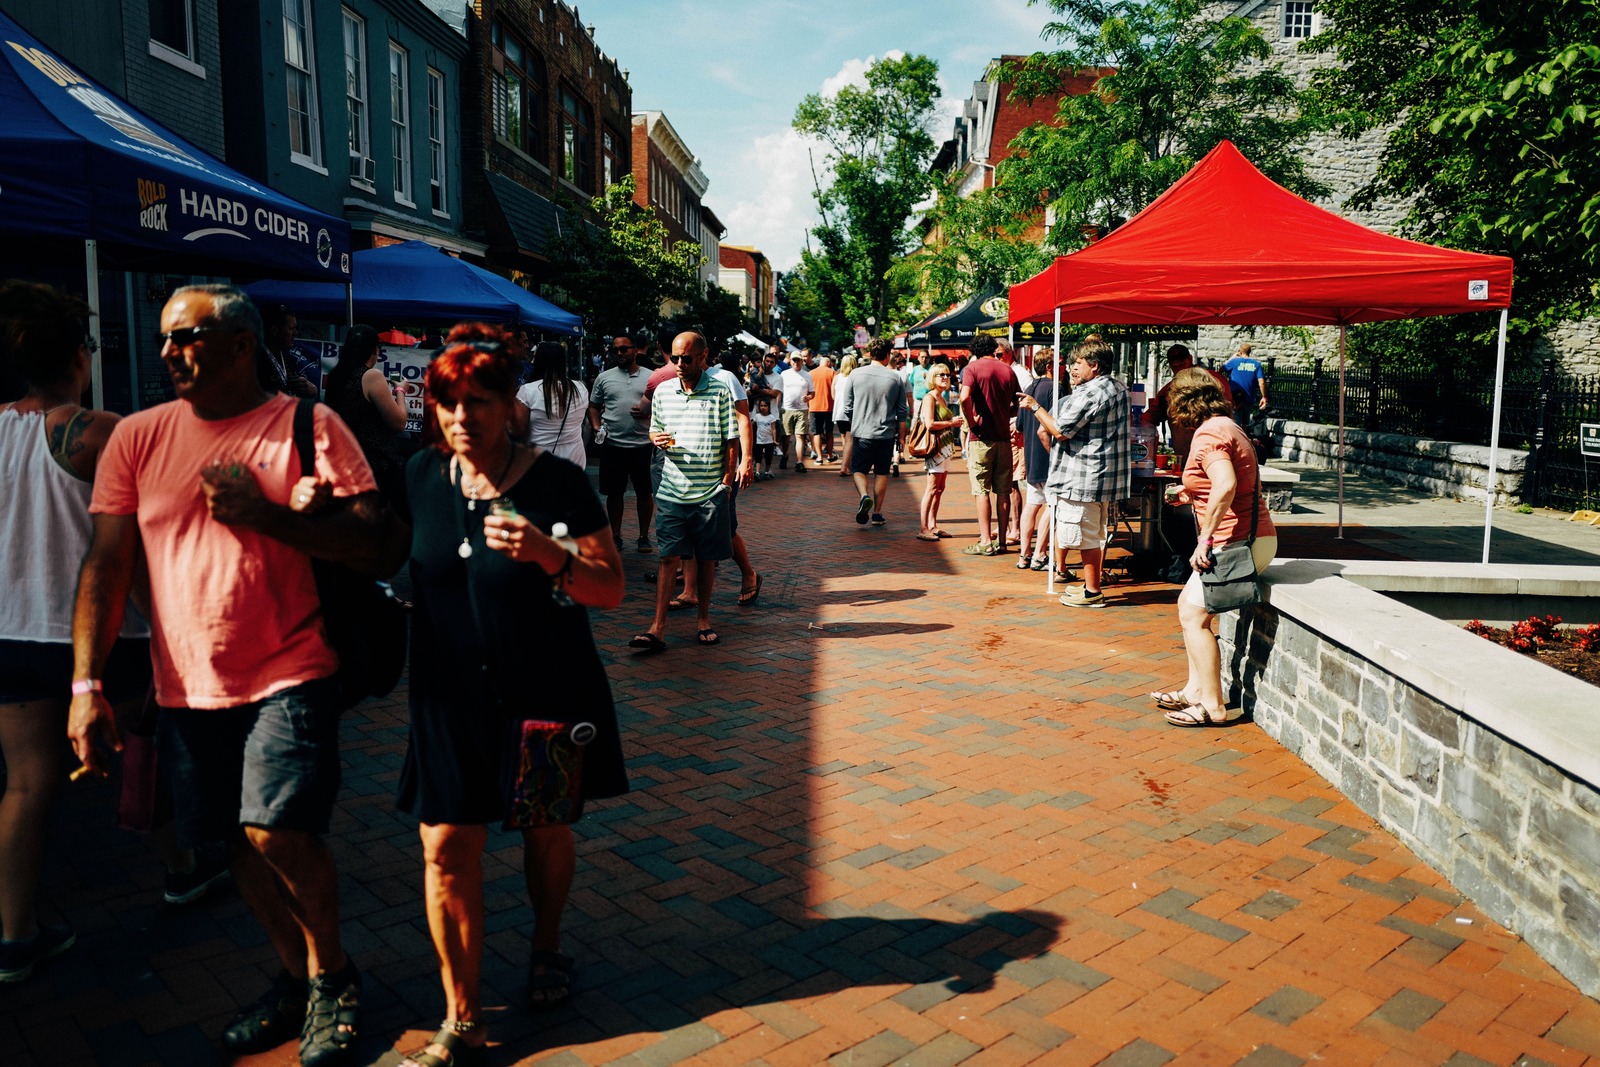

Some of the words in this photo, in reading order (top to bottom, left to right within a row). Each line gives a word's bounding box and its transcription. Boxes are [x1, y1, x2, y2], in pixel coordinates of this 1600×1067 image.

[137, 177, 167, 209] BOLD
[140, 203, 169, 232] ROCK
[180, 188, 248, 227] HARD
[254, 207, 310, 244] CIDER
